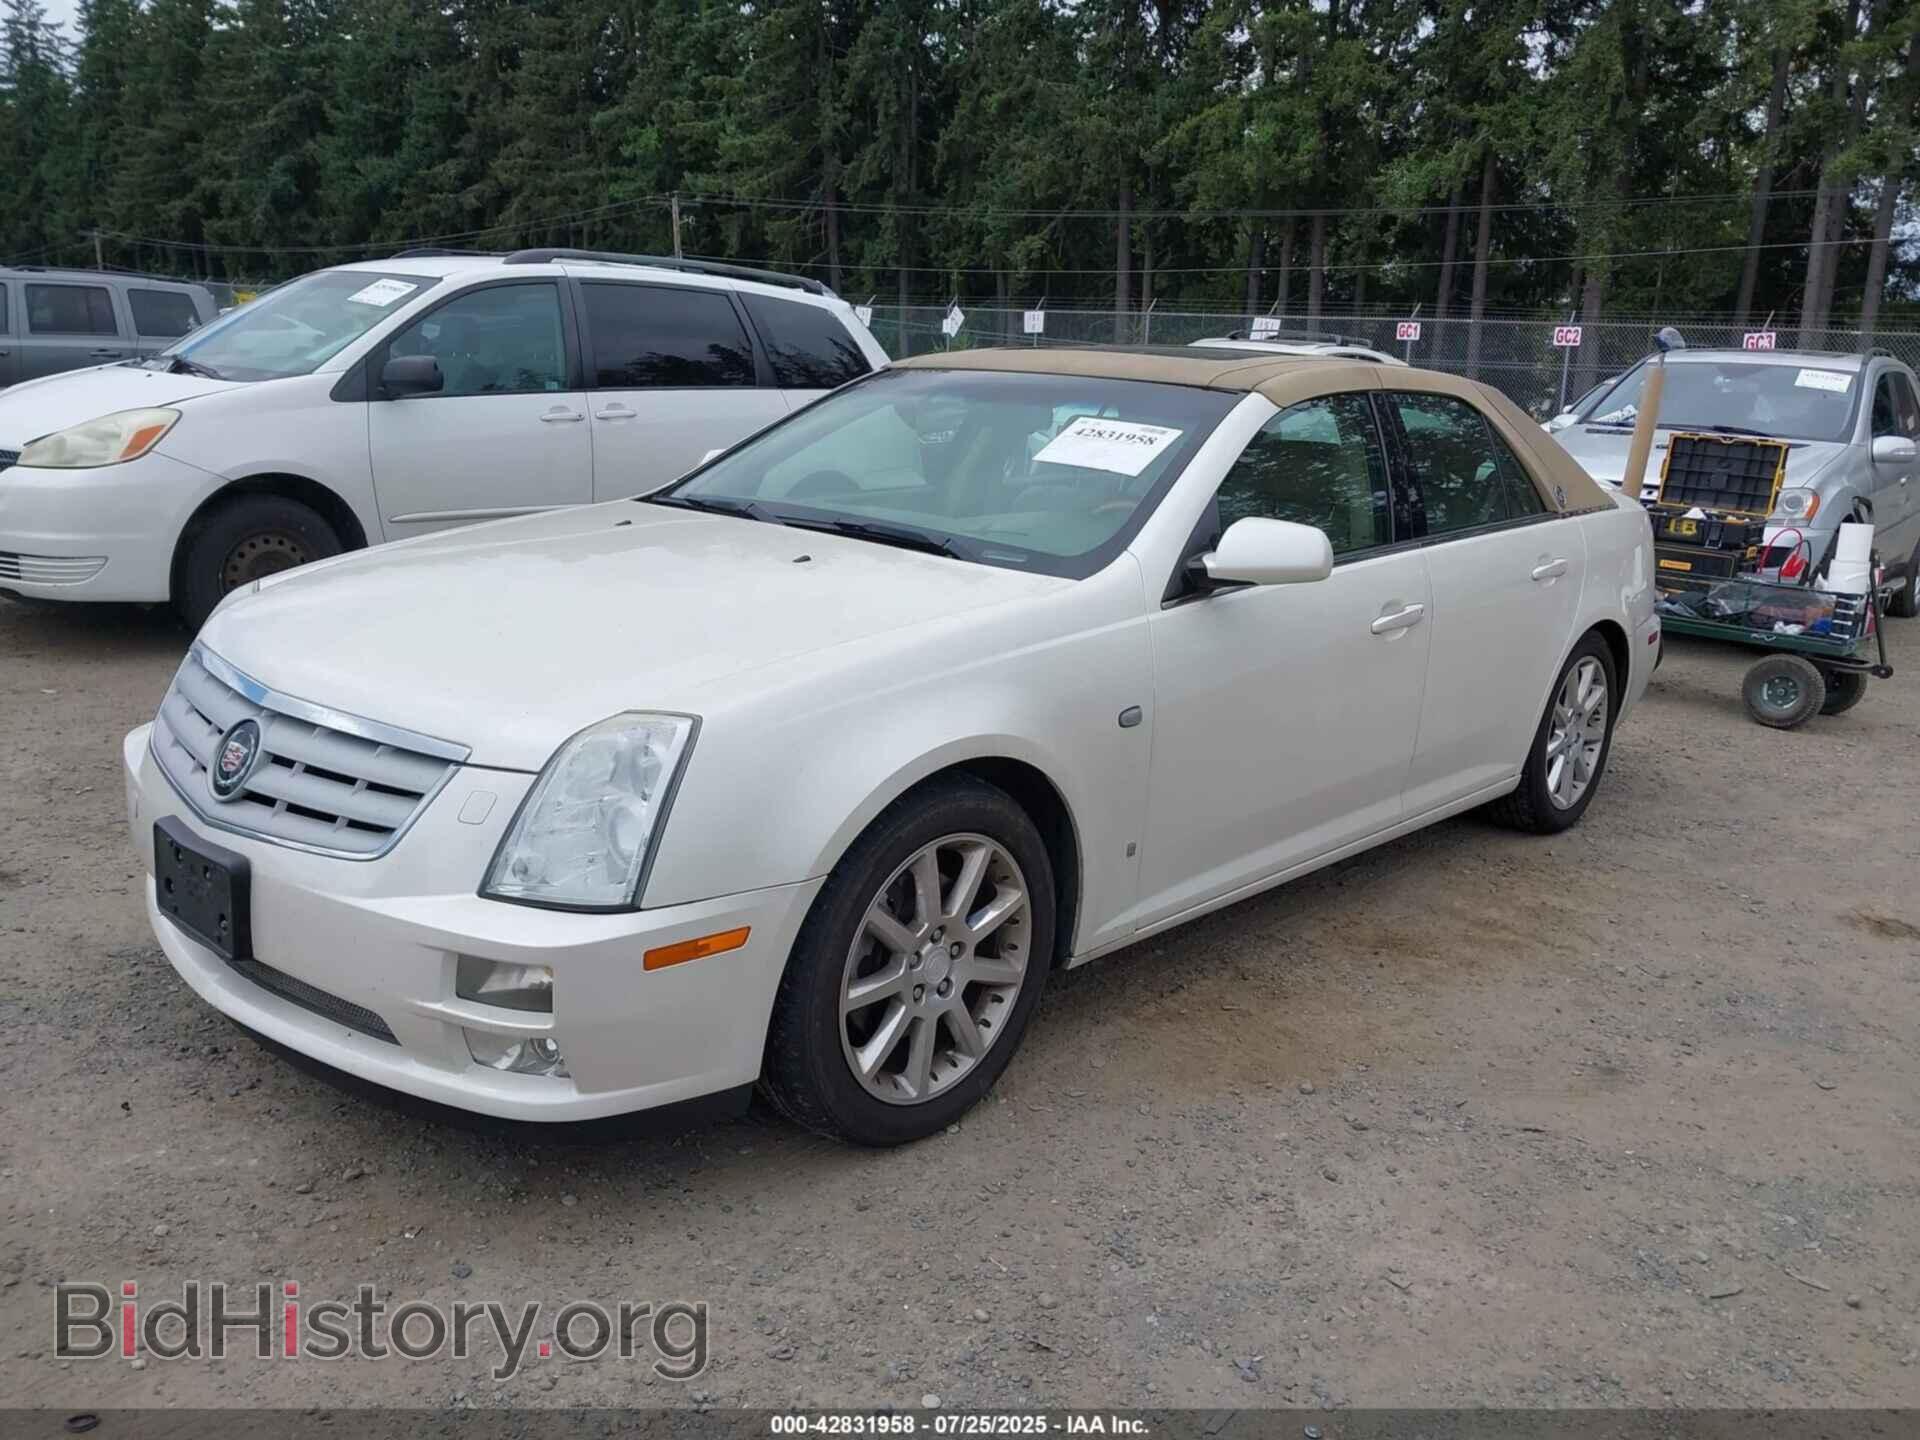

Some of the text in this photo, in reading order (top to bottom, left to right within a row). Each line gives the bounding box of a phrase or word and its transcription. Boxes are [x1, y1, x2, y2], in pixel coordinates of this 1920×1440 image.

[1556, 328, 1580, 344] GC2
[1746, 334, 1773, 350] GC3
[1074, 427, 1158, 446] 42831958
